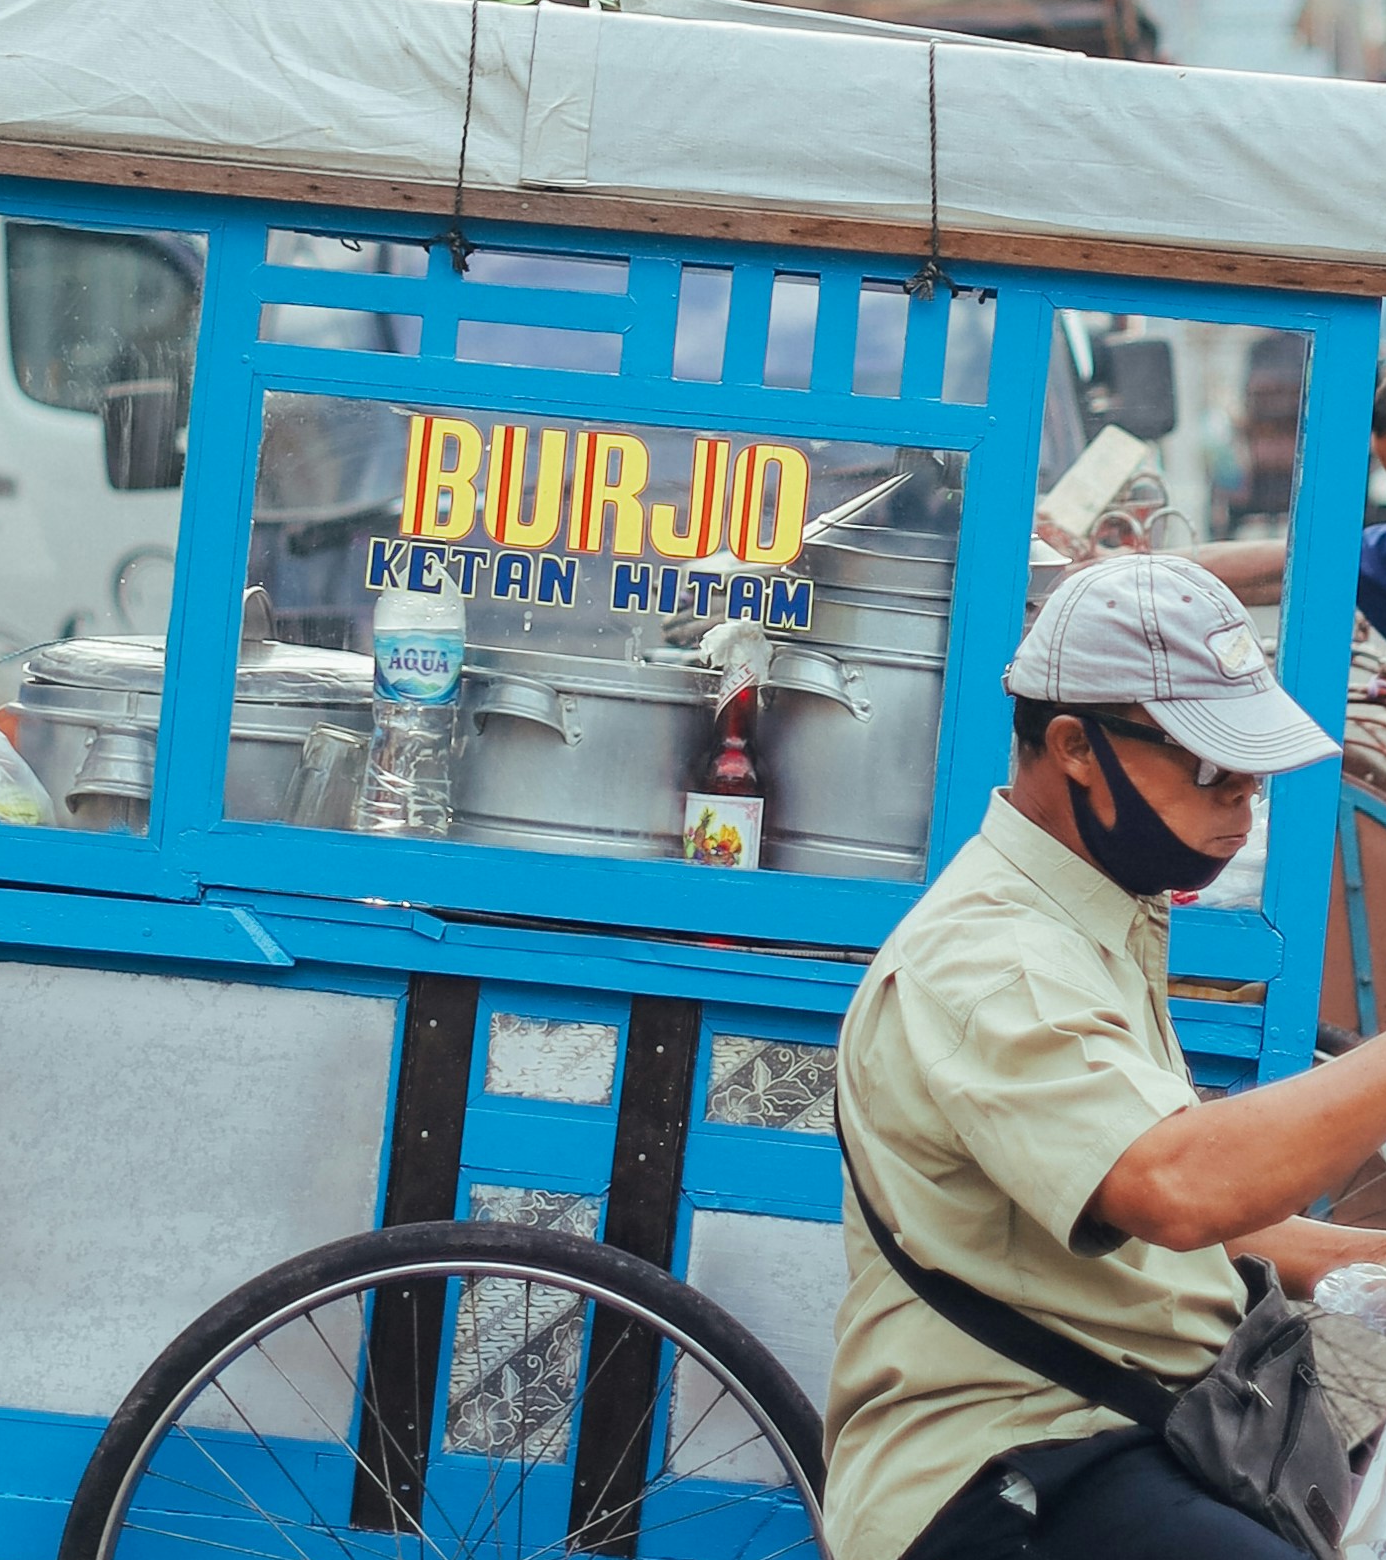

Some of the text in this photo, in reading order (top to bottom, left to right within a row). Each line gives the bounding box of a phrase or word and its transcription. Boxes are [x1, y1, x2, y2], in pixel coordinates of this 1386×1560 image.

[400, 414, 810, 566] BURJO
[365, 535, 815, 632] KETAN HITAM
[388, 647, 450, 677] AQUA
